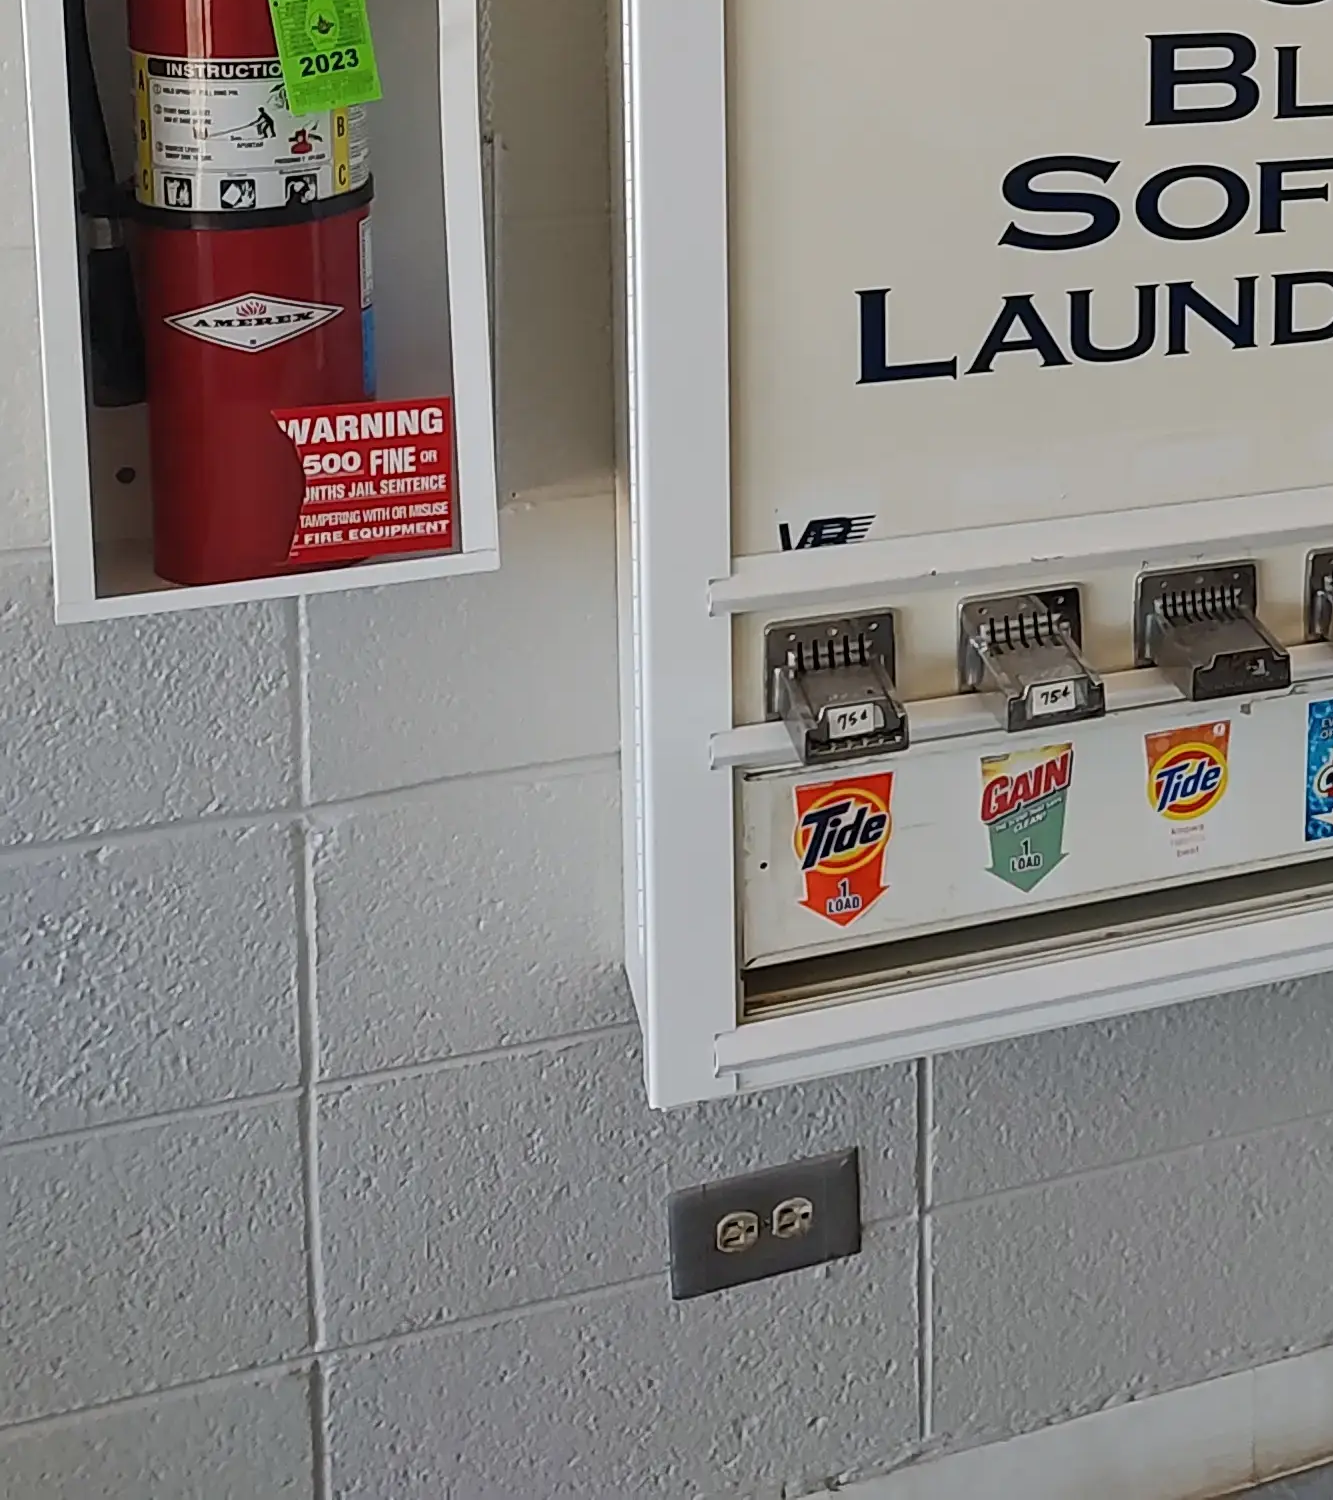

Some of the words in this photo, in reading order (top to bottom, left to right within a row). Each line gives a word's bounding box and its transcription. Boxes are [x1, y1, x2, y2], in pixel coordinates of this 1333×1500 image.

[299, 48, 360, 78] 2023
[336, 116, 345, 137] B
[338, 164, 346, 185] C
[193, 310, 315, 328] AMEREX
[278, 407, 443, 445] WARNING
[370, 446, 416, 476] FINE
[420, 450, 437, 464] OR
[348, 481, 377, 498] JAIL
[379, 474, 447, 495] SENTENCE
[300, 509, 360, 529] TAMPERING
[362, 506, 390, 522] WITH
[391, 505, 406, 519] OR
[408, 501, 449, 518] MISUSE
[304, 529, 344, 545] FIRE
[348, 520, 449, 541] EQUIPMENT
[981, 752, 1069, 822] GAIN
[1156, 761, 1221, 812] Tide
[801, 801, 887, 870] Tide
[1022, 839, 1029, 855] 1
[1012, 855, 1041, 872] LOAD
[839, 880, 848, 897] 1
[828, 896, 860, 913] LOAD
